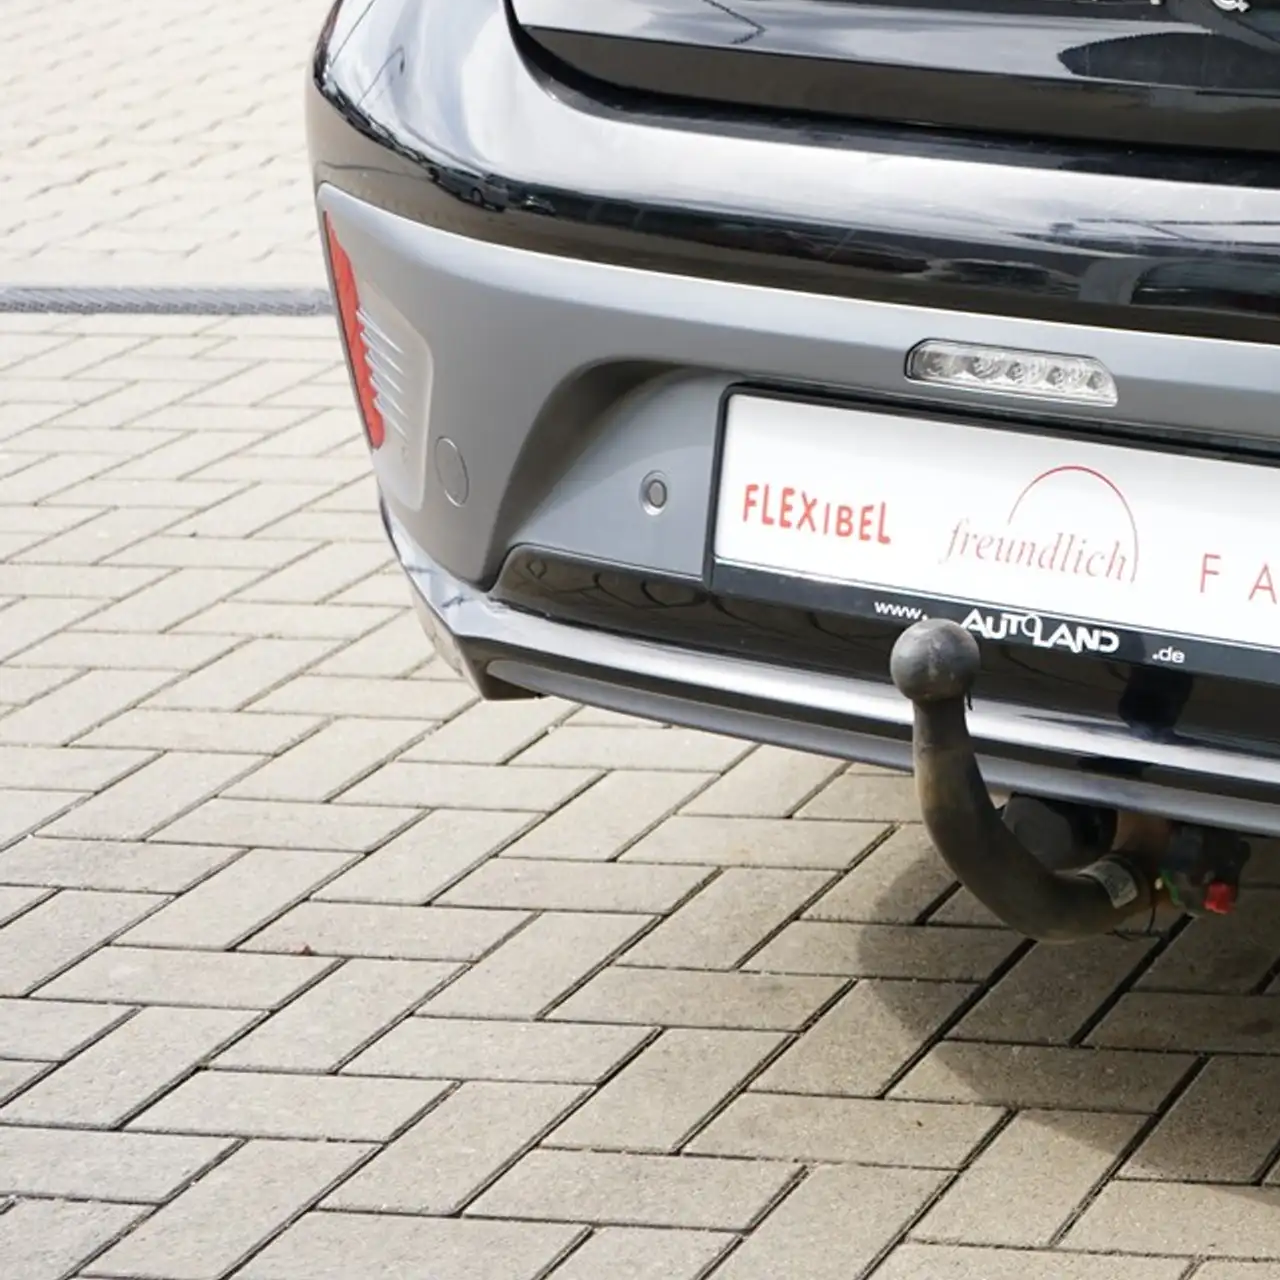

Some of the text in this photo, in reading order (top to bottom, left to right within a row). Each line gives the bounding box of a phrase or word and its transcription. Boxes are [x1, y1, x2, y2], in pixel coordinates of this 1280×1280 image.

[742, 482, 891, 545] FLEXIBEL
[938, 517, 1129, 582] freundlich
[874, 601, 1185, 664] www. AUTOLAND .de
